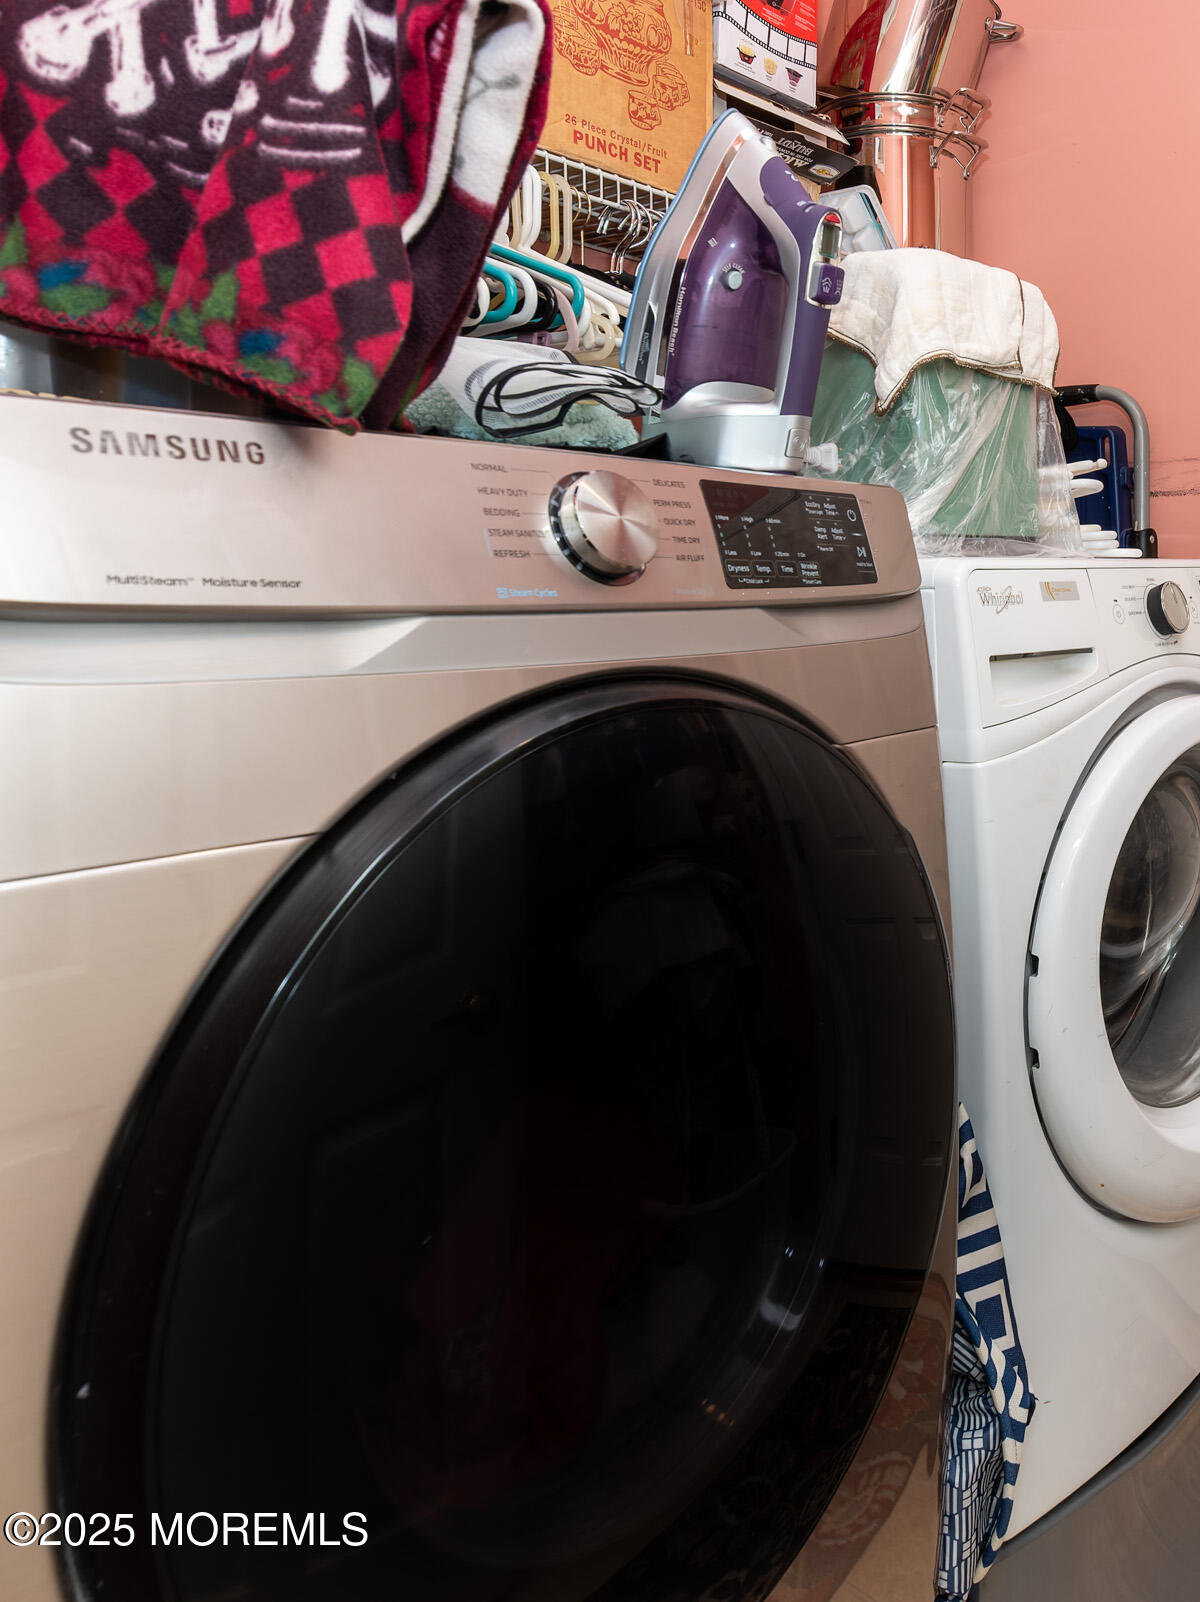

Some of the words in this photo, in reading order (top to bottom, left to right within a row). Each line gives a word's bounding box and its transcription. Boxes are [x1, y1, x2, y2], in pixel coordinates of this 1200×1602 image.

[564, 113, 577, 126] 26
[581, 119, 606, 136] Piece
[610, 130, 668, 159] Crystal/Fruit
[573, 129, 628, 162] PUNCH
[633, 151, 661, 174] SET
[673, 286, 687, 326] Hamilton
[69, 427, 266, 465] SAMSUNG
[470, 463, 508, 473] NORMAL
[653, 479, 686, 489] DELICATES
[477, 487, 505, 496] HEAVY
[506, 489, 528, 497] DUTY
[653, 499, 671, 508] PERM
[672, 500, 692, 509] PRESS
[482, 507, 521, 518] BEDDING
[663, 518, 682, 526] QUICK
[487, 528, 514, 538] STEAM
[672, 536, 687, 544] TIME
[688, 536, 701, 544] DRY
[493, 549, 532, 558] REFRESH
[687, 554, 705, 562] FLUFF
[727, 564, 750, 574] Dryness
[780, 565, 794, 573] Time
[201, 577, 258, 588] Moisture
[259, 578, 302, 589] Sensor
[979, 590, 1024, 608] Whirlpool
